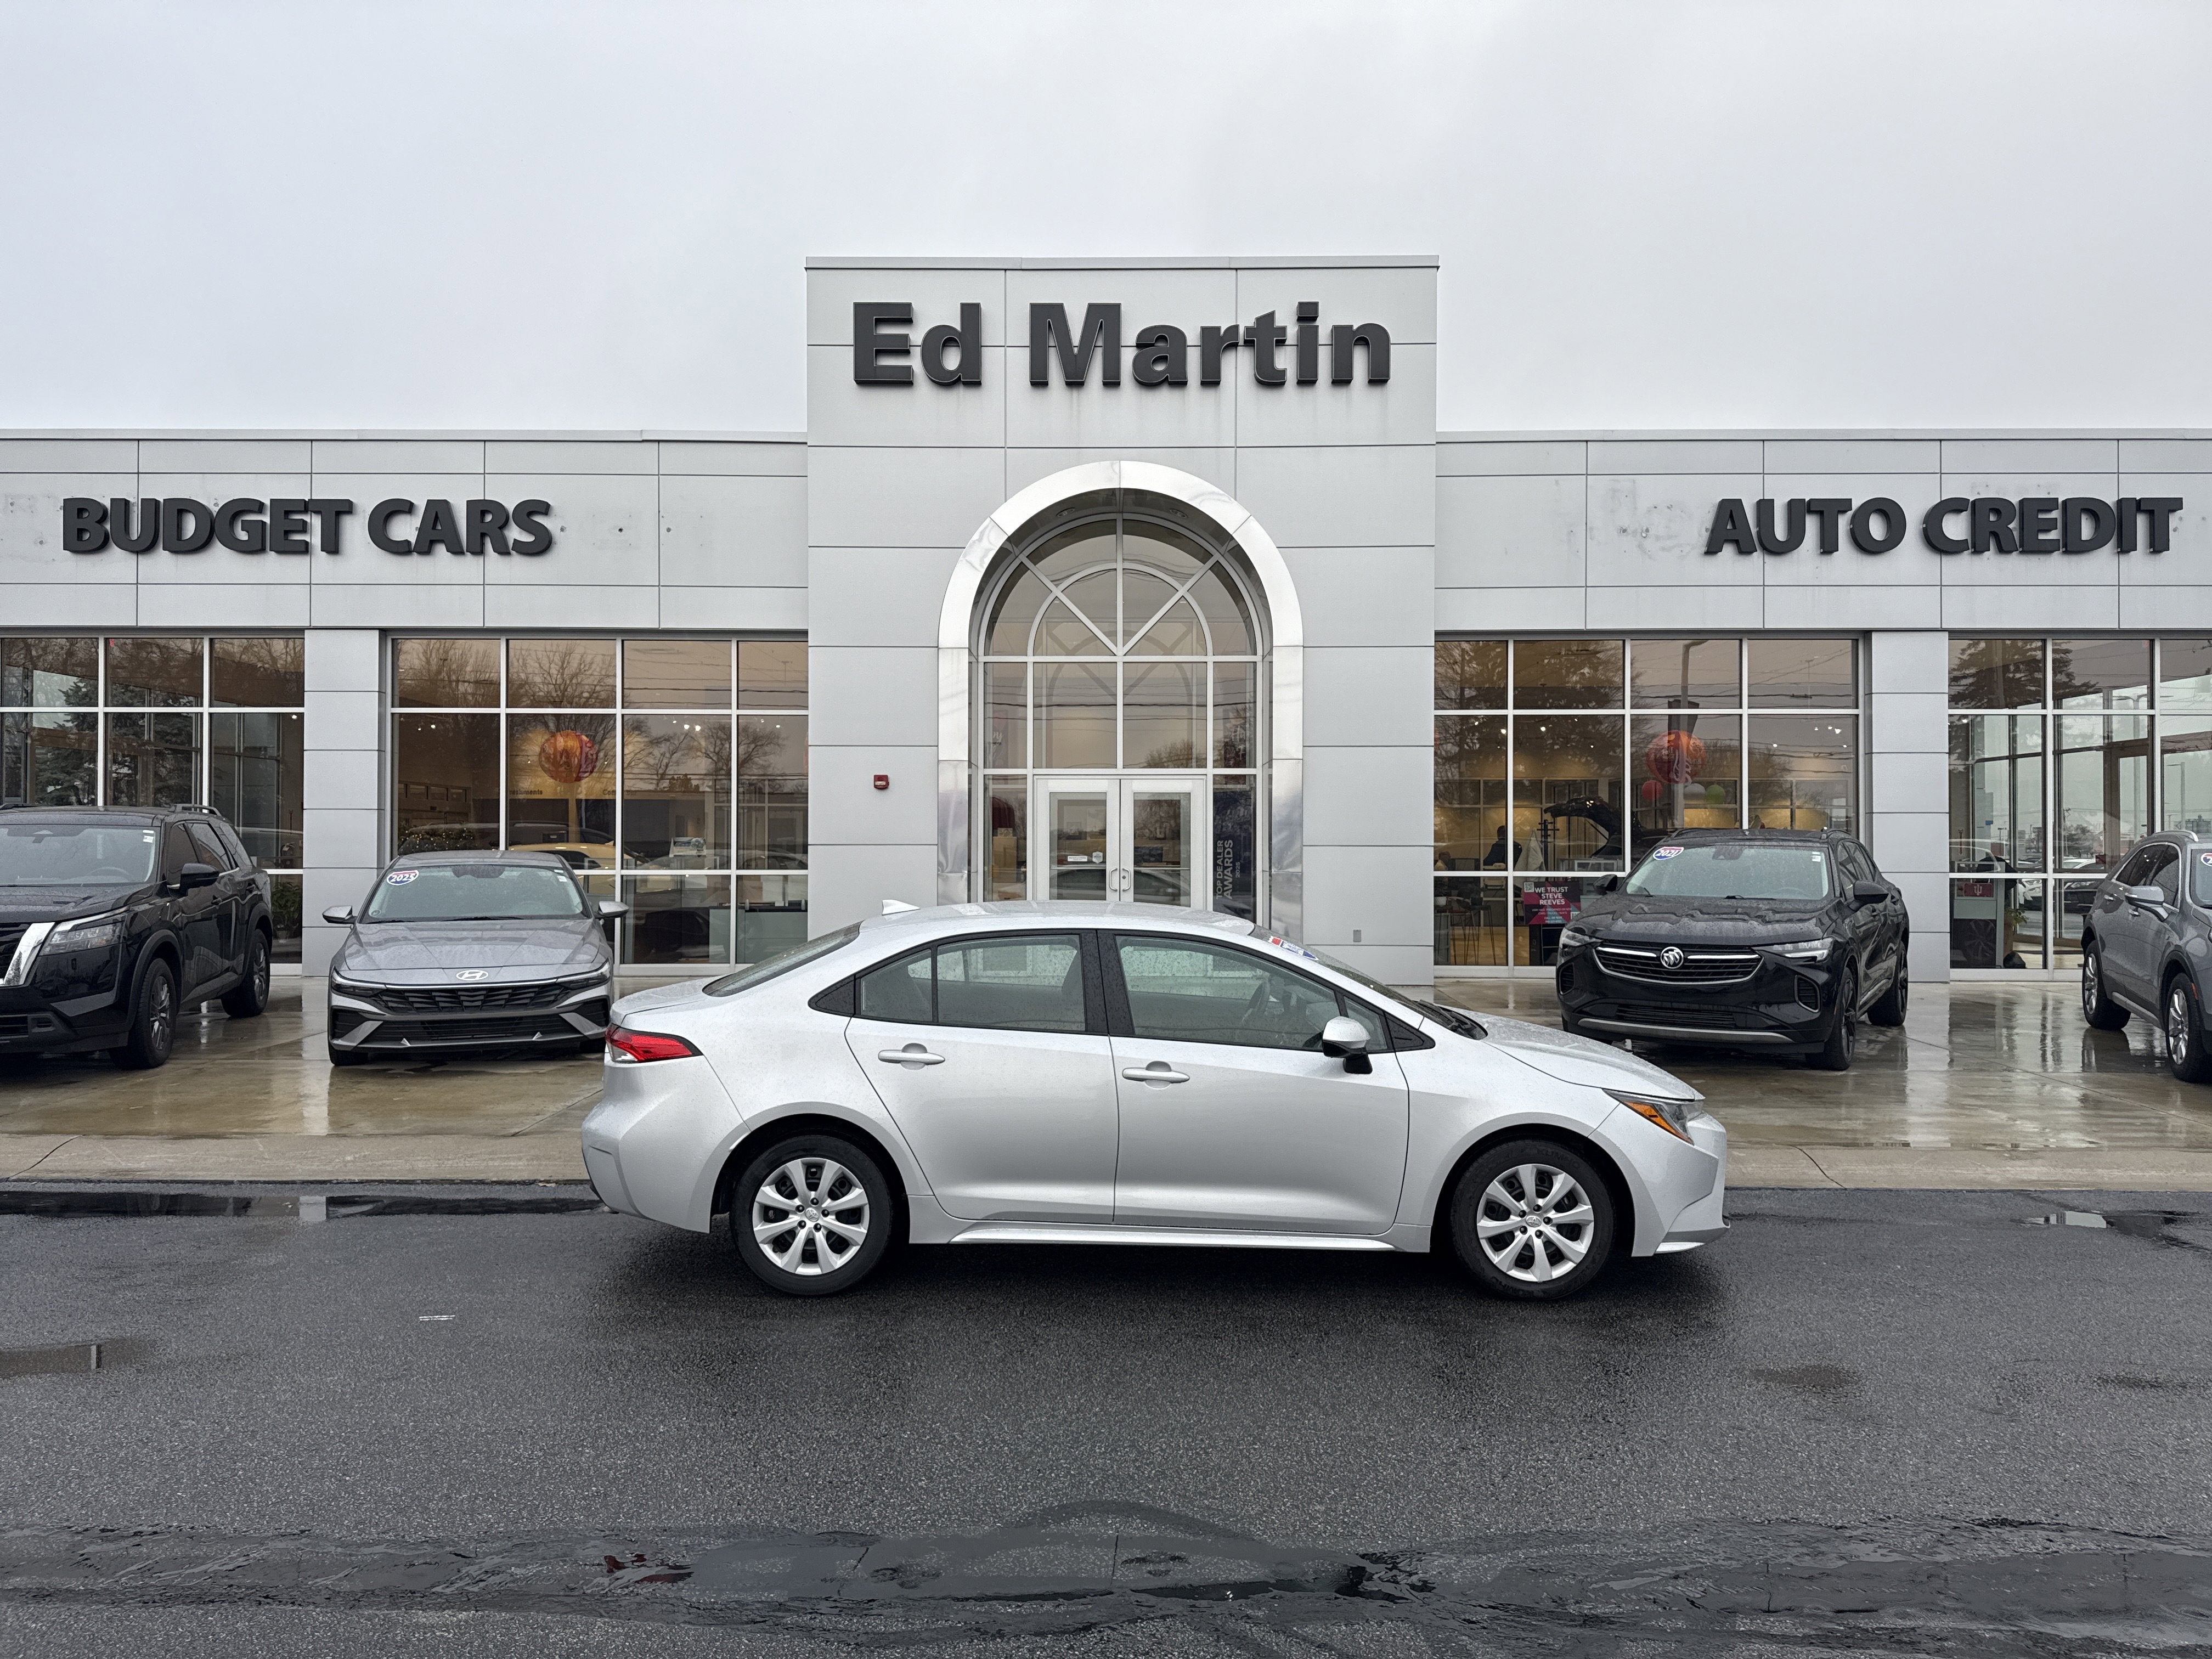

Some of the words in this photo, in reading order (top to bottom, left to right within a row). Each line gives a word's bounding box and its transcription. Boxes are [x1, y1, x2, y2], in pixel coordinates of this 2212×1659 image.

[853, 302, 981, 386] Ed
[1029, 301, 1390, 386] Martin
[63, 497, 352, 555] BUDGET
[367, 499, 552, 556] CARS
[1704, 496, 1907, 555] AUTO
[1923, 496, 2183, 556] CREDIT
[390, 873, 416, 882] 2025
[1223, 839, 1233, 900] AWARDS
[1655, 849, 1680, 857] 2021
